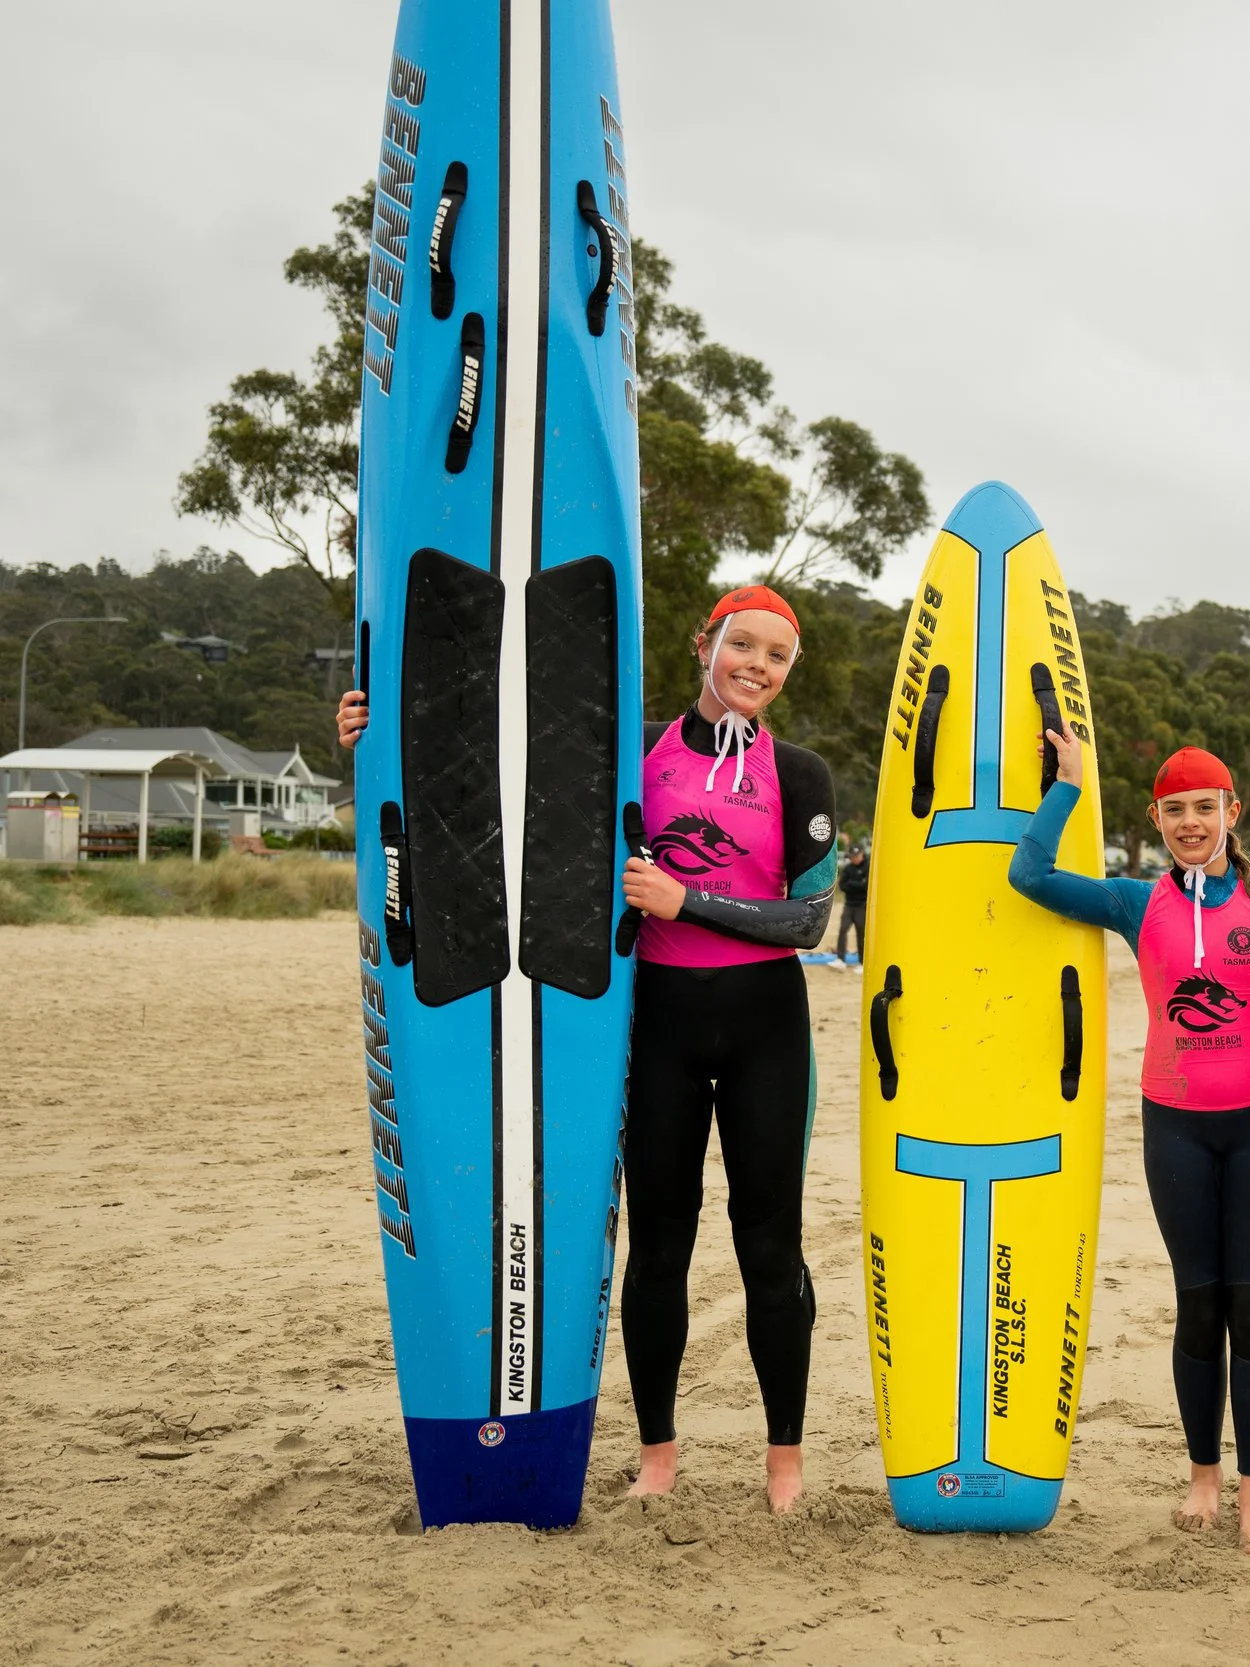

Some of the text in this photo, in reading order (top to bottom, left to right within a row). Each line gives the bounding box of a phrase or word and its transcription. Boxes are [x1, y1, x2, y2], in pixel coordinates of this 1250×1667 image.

[363, 51, 426, 397] BENNETT
[429, 197, 452, 274] BENNETT
[455, 354, 479, 433] BENNETT
[893, 581, 944, 752] BENNETT
[1040, 578, 1091, 746] BENNETT
[723, 795, 770, 815] TASMANIA
[384, 845, 401, 920] BENNETT
[703, 881, 732, 892] BEACH
[359, 918, 416, 1260] BENNETT
[1175, 1034, 1242, 1047] KINGSTON BEACH
[508, 1223, 527, 1402] KINGSTON BEACH
[870, 1231, 893, 1368] BENNETT
[993, 1243, 1012, 1419] KINGSTON BEACH
[1011, 1298, 1027, 1364] S.L.S.C.
[1055, 1232, 1087, 1439] BENNETT TORPEDO 45
[881, 1372, 892, 1426] TORPEDO
